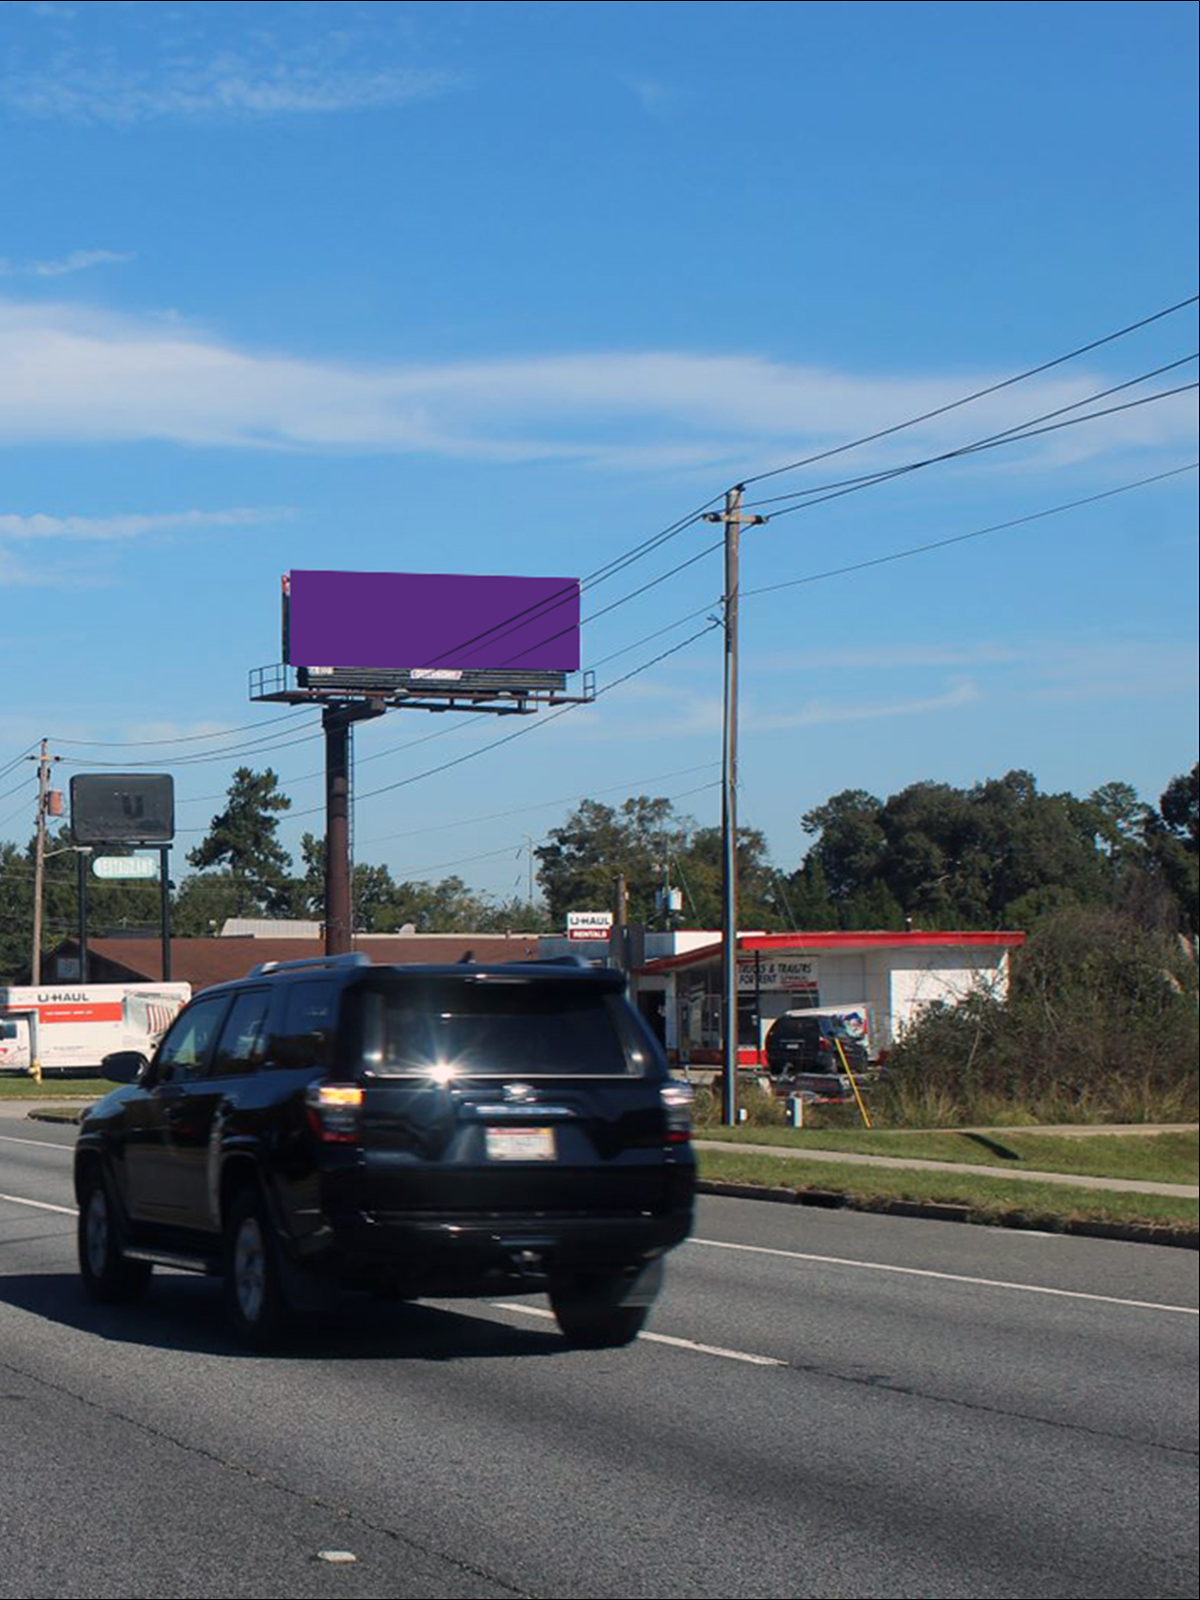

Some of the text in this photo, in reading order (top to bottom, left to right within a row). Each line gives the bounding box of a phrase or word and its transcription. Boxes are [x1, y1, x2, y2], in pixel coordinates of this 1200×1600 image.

[570, 917, 610, 925] U-HAUL
[738, 964, 766, 974] TRUCS
[37, 992, 89, 1003] U-HAUL
